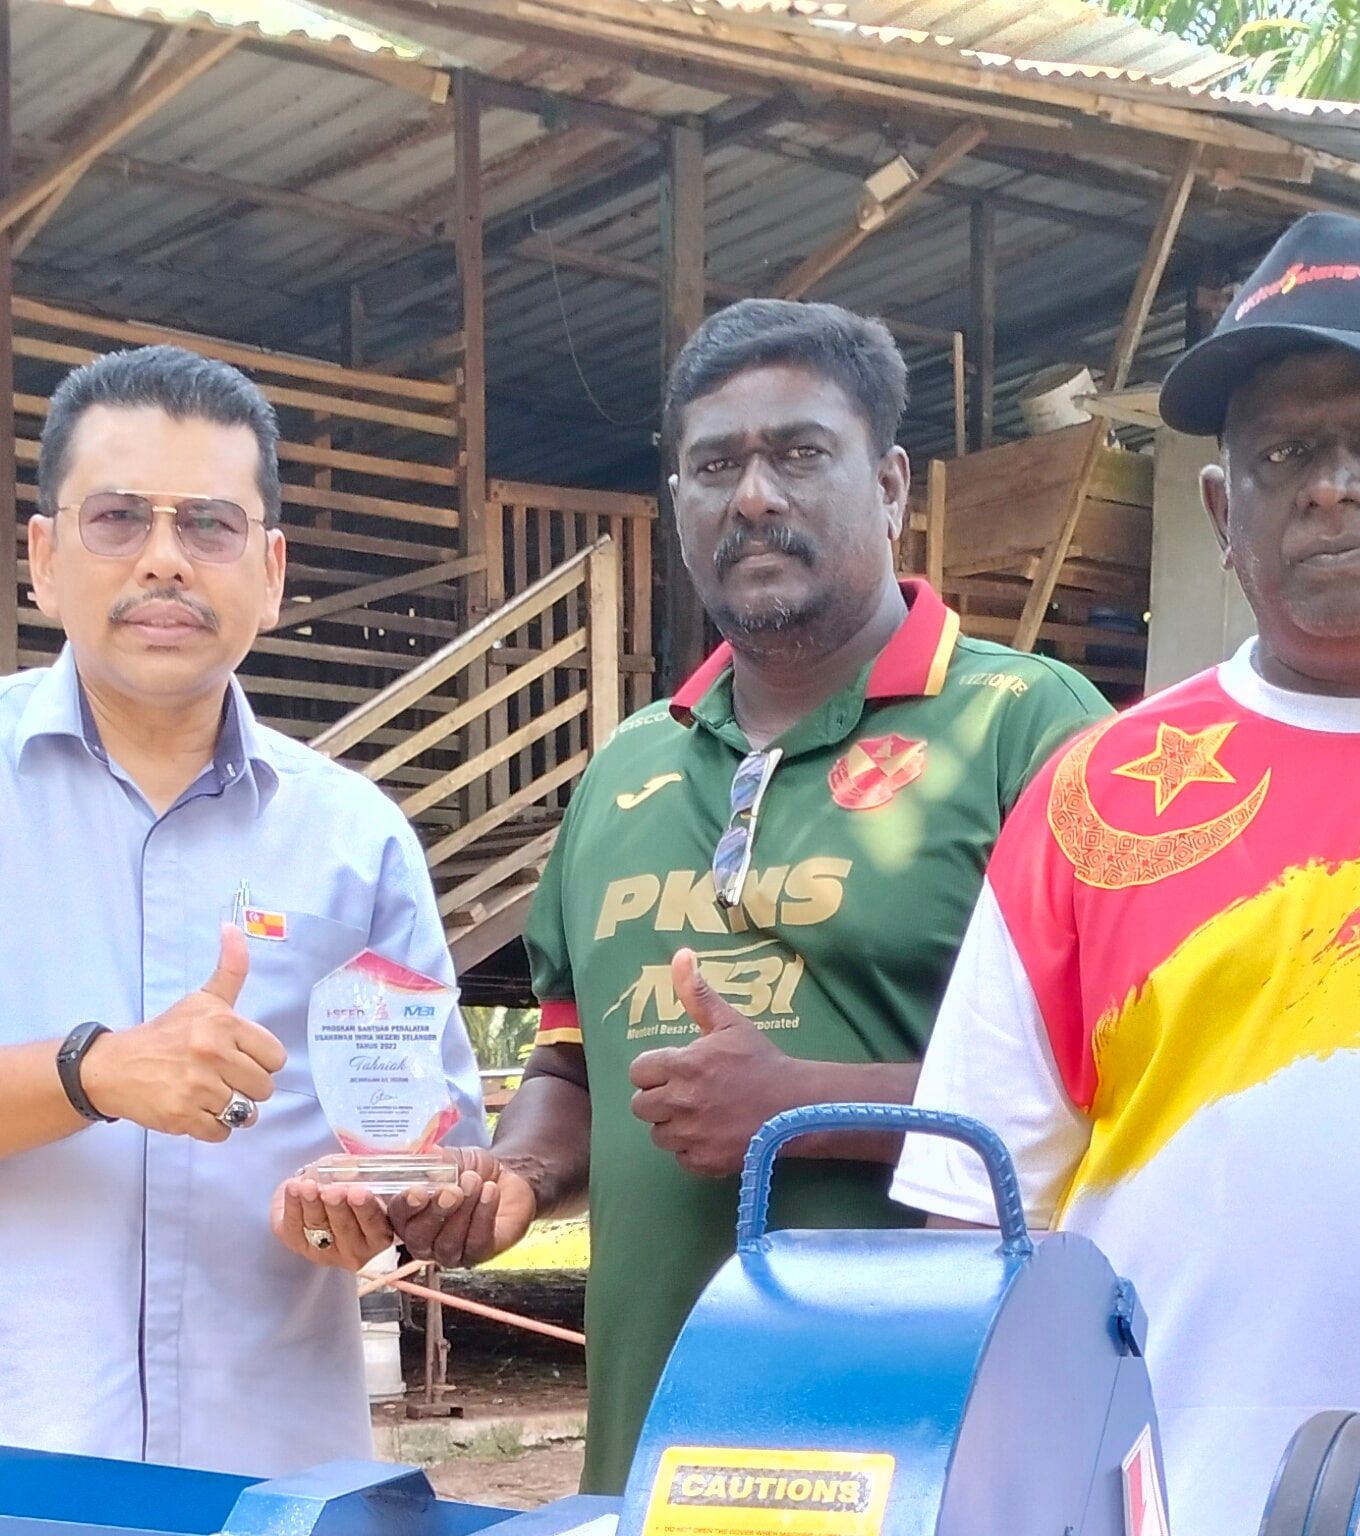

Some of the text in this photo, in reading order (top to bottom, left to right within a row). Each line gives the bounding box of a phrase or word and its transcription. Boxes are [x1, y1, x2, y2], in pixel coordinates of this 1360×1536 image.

[593, 856, 854, 941] PKNS
[626, 1023, 658, 1041] Menteri
[660, 1024, 689, 1036] Besar
[349, 1055, 408, 1071] Tahniah
[681, 1474, 861, 1504] CAUTIONS
